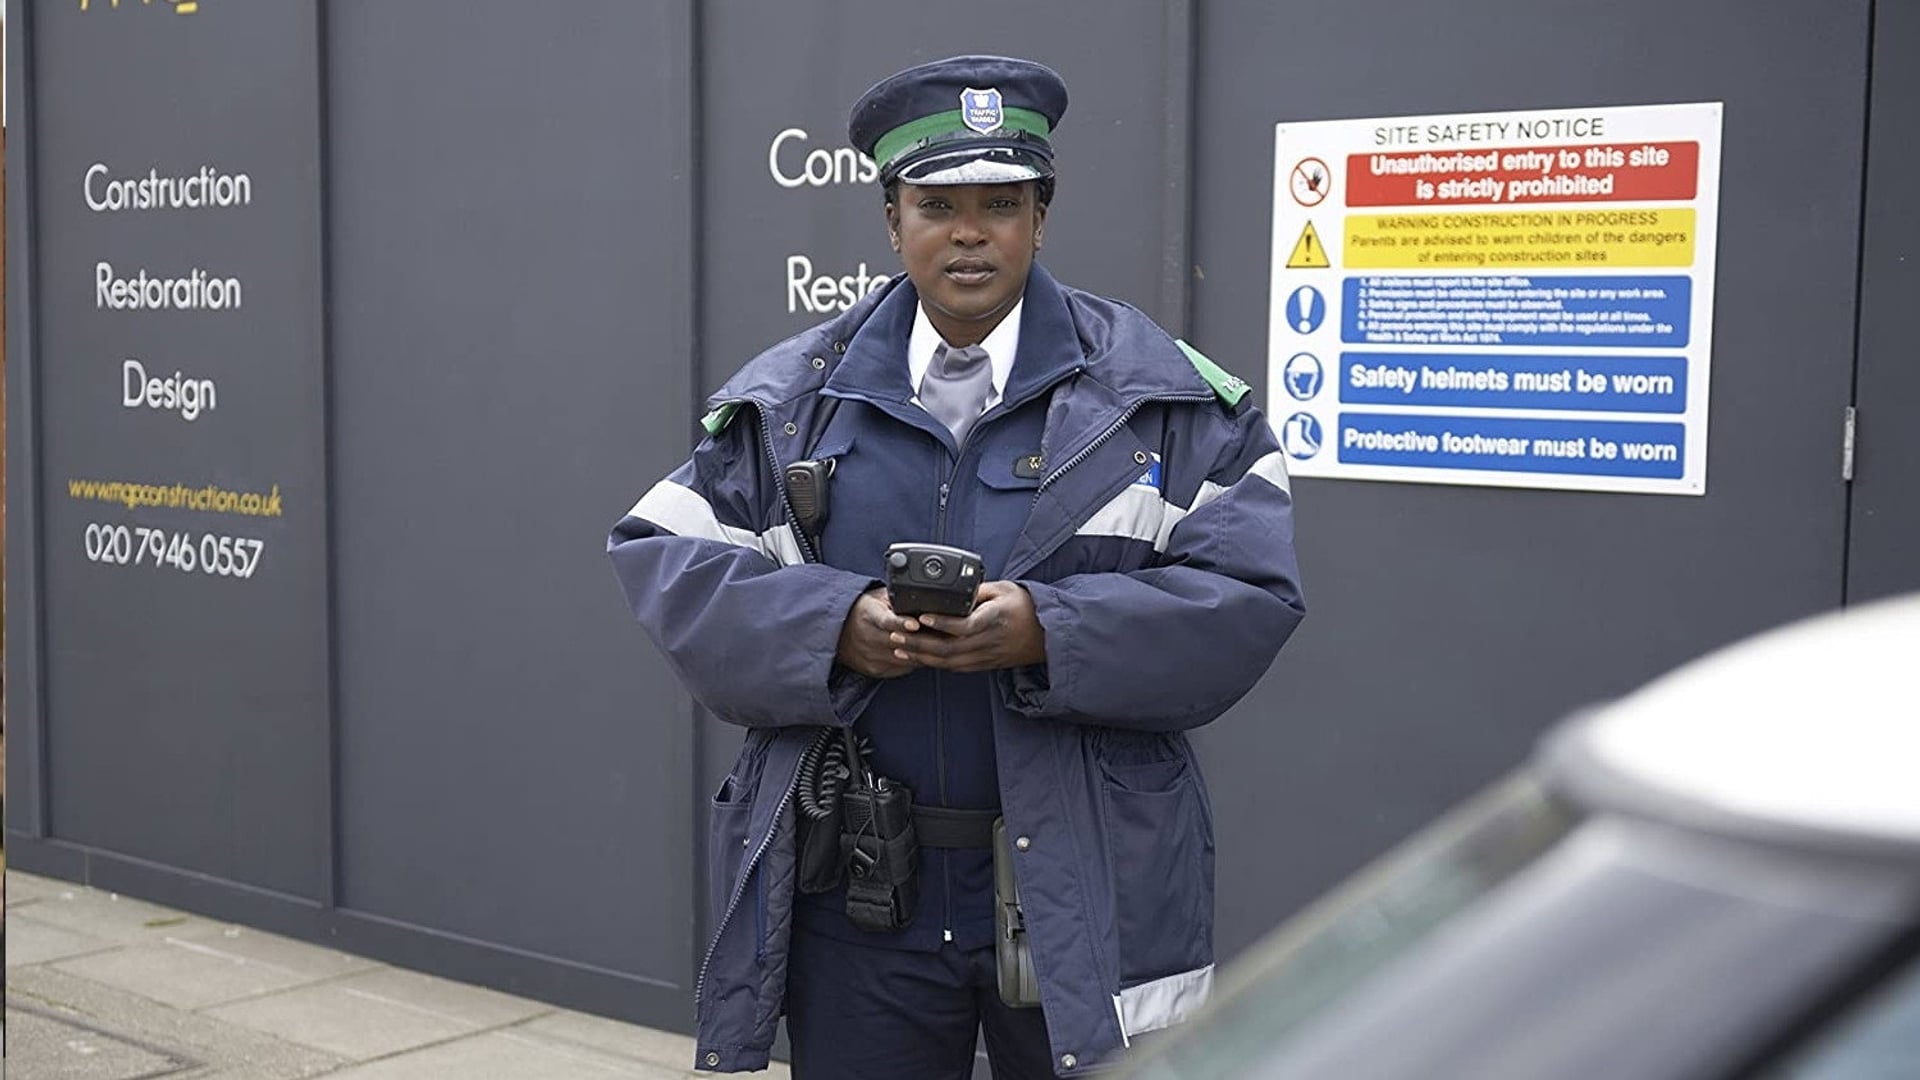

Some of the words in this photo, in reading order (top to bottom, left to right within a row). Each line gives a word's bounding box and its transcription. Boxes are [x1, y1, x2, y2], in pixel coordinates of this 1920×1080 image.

[1375, 127, 1418, 145] SITE
[1427, 122, 1509, 142] SAFETY
[1517, 118, 1604, 138] NOTICE
[769, 128, 878, 187] Cons
[1371, 151, 1498, 175] Unauthorised
[1503, 149, 1555, 173] entry
[1559, 149, 1581, 168] to
[1585, 147, 1625, 167] this
[1629, 146, 1670, 166] site
[84, 164, 250, 211] Construction
[1416, 180, 1434, 199] is
[1438, 175, 1505, 201] strictly
[1508, 173, 1614, 200] prohibited
[1377, 217, 1439, 229] WARNING
[1443, 214, 1552, 228] CONSTRUCTION
[1558, 214, 1571, 225] IN
[1576, 212, 1658, 225] PROGRESS
[1352, 234, 1396, 246] Parents
[1401, 236, 1420, 245] are
[1424, 234, 1472, 245] advised
[1476, 234, 1489, 244] to
[1493, 234, 1524, 244] warn
[1528, 231, 1582, 244] children
[1585, 231, 1600, 243] of
[1603, 232, 1625, 243] the
[1629, 231, 1687, 246] dangers
[1418, 252, 1430, 262] of
[1434, 252, 1486, 265] entering
[1490, 249, 1571, 262] construction
[1575, 250, 1607, 261] sites
[96, 262, 241, 310] Restoration
[123, 360, 215, 421] Design
[1351, 364, 1417, 394] Safety
[1421, 367, 1508, 391] helmets
[1514, 369, 1571, 392] must
[1576, 370, 1606, 392] be
[1613, 373, 1673, 394] worn
[1344, 428, 1438, 452] Protective
[1442, 432, 1529, 456] footwear
[1533, 436, 1586, 458] must
[1590, 437, 1617, 459] be
[1623, 441, 1677, 461] worn
[85, 523, 131, 565] 020
[134, 527, 196, 572] 7946
[200, 533, 264, 579] 0557
